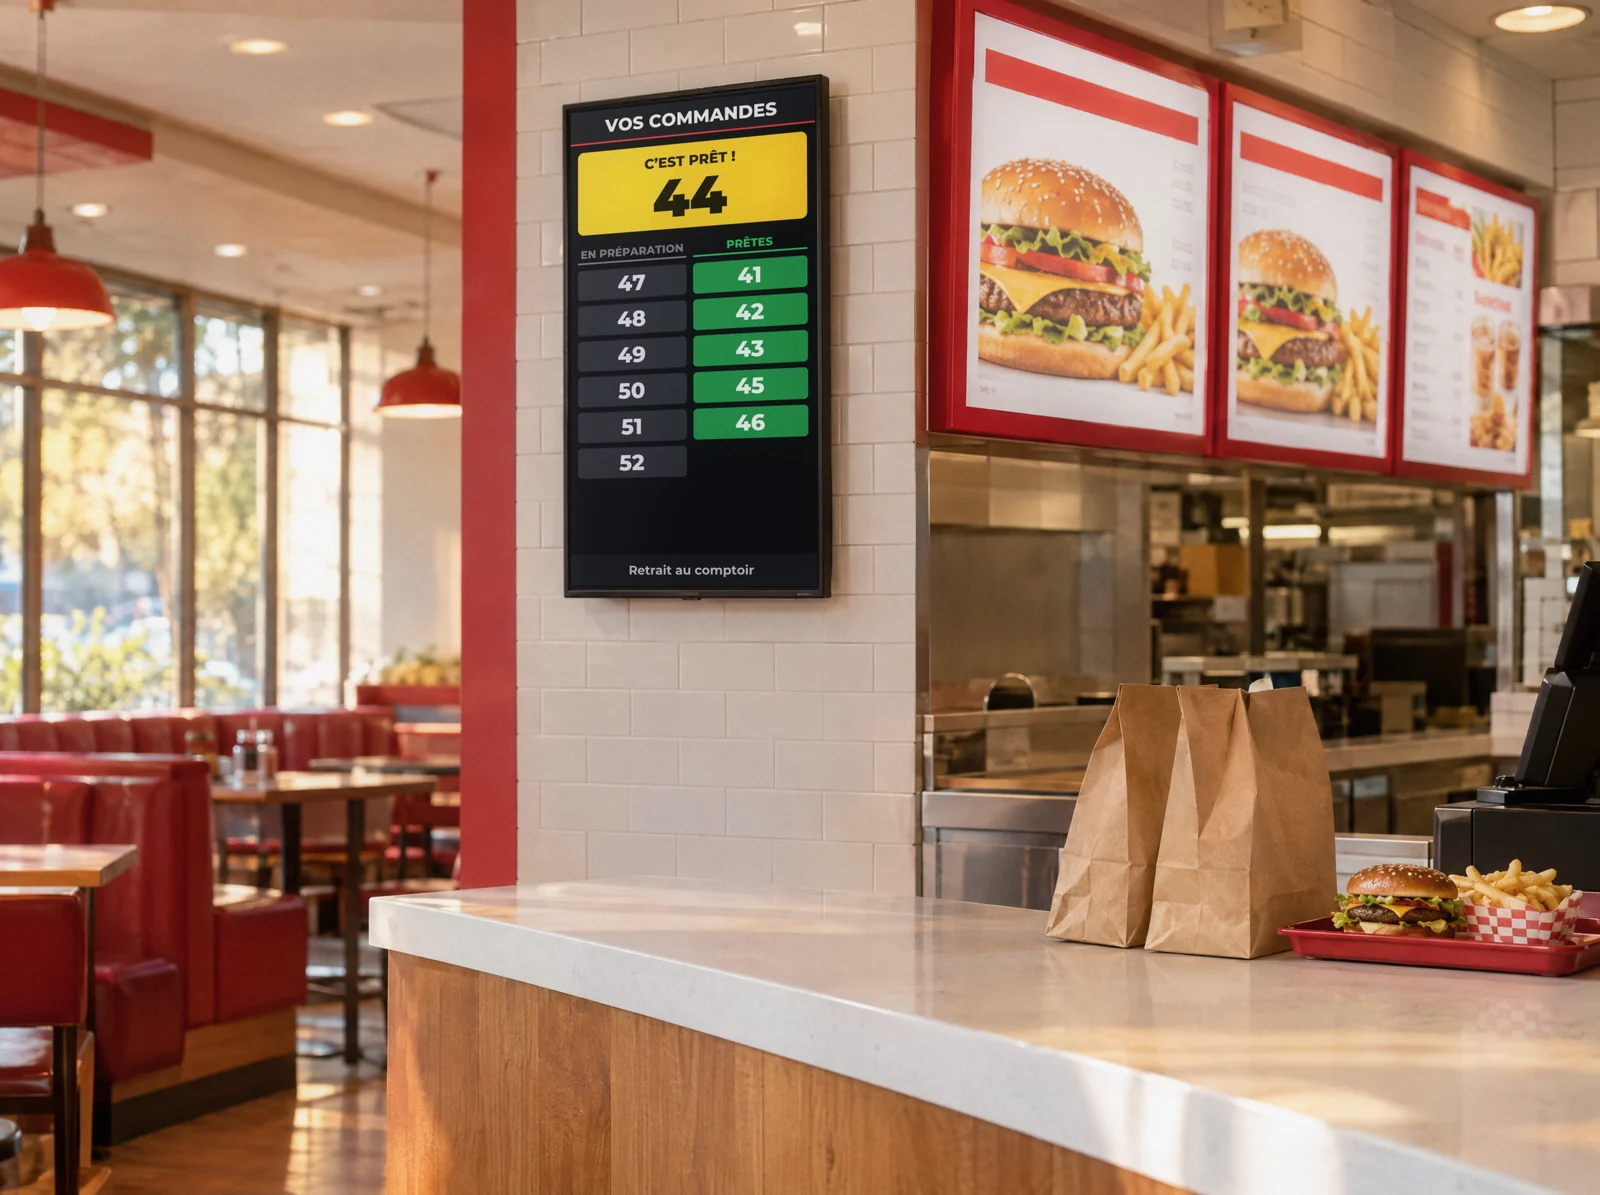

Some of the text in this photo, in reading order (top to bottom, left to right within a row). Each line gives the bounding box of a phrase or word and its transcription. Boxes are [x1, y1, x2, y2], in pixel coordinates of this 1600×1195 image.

[605, 101, 777, 133] VOS COMMANDES
[689, 150, 728, 166] PRÊT
[653, 175, 727, 217] 44
[726, 236, 773, 249] PRÊTES
[580, 243, 684, 260] EN PRÉPARATION
[617, 274, 646, 292] 47
[737, 266, 761, 283] 41
[617, 310, 646, 327] 48
[736, 303, 764, 320] 42
[617, 346, 646, 363] 49
[736, 340, 764, 357] 43
[618, 382, 645, 399] 50
[736, 377, 765, 394] 45
[621, 418, 642, 435] 51
[735, 414, 765, 431] 46
[619, 454, 645, 471] 52
[629, 564, 754, 578] Retrait au comptoir
